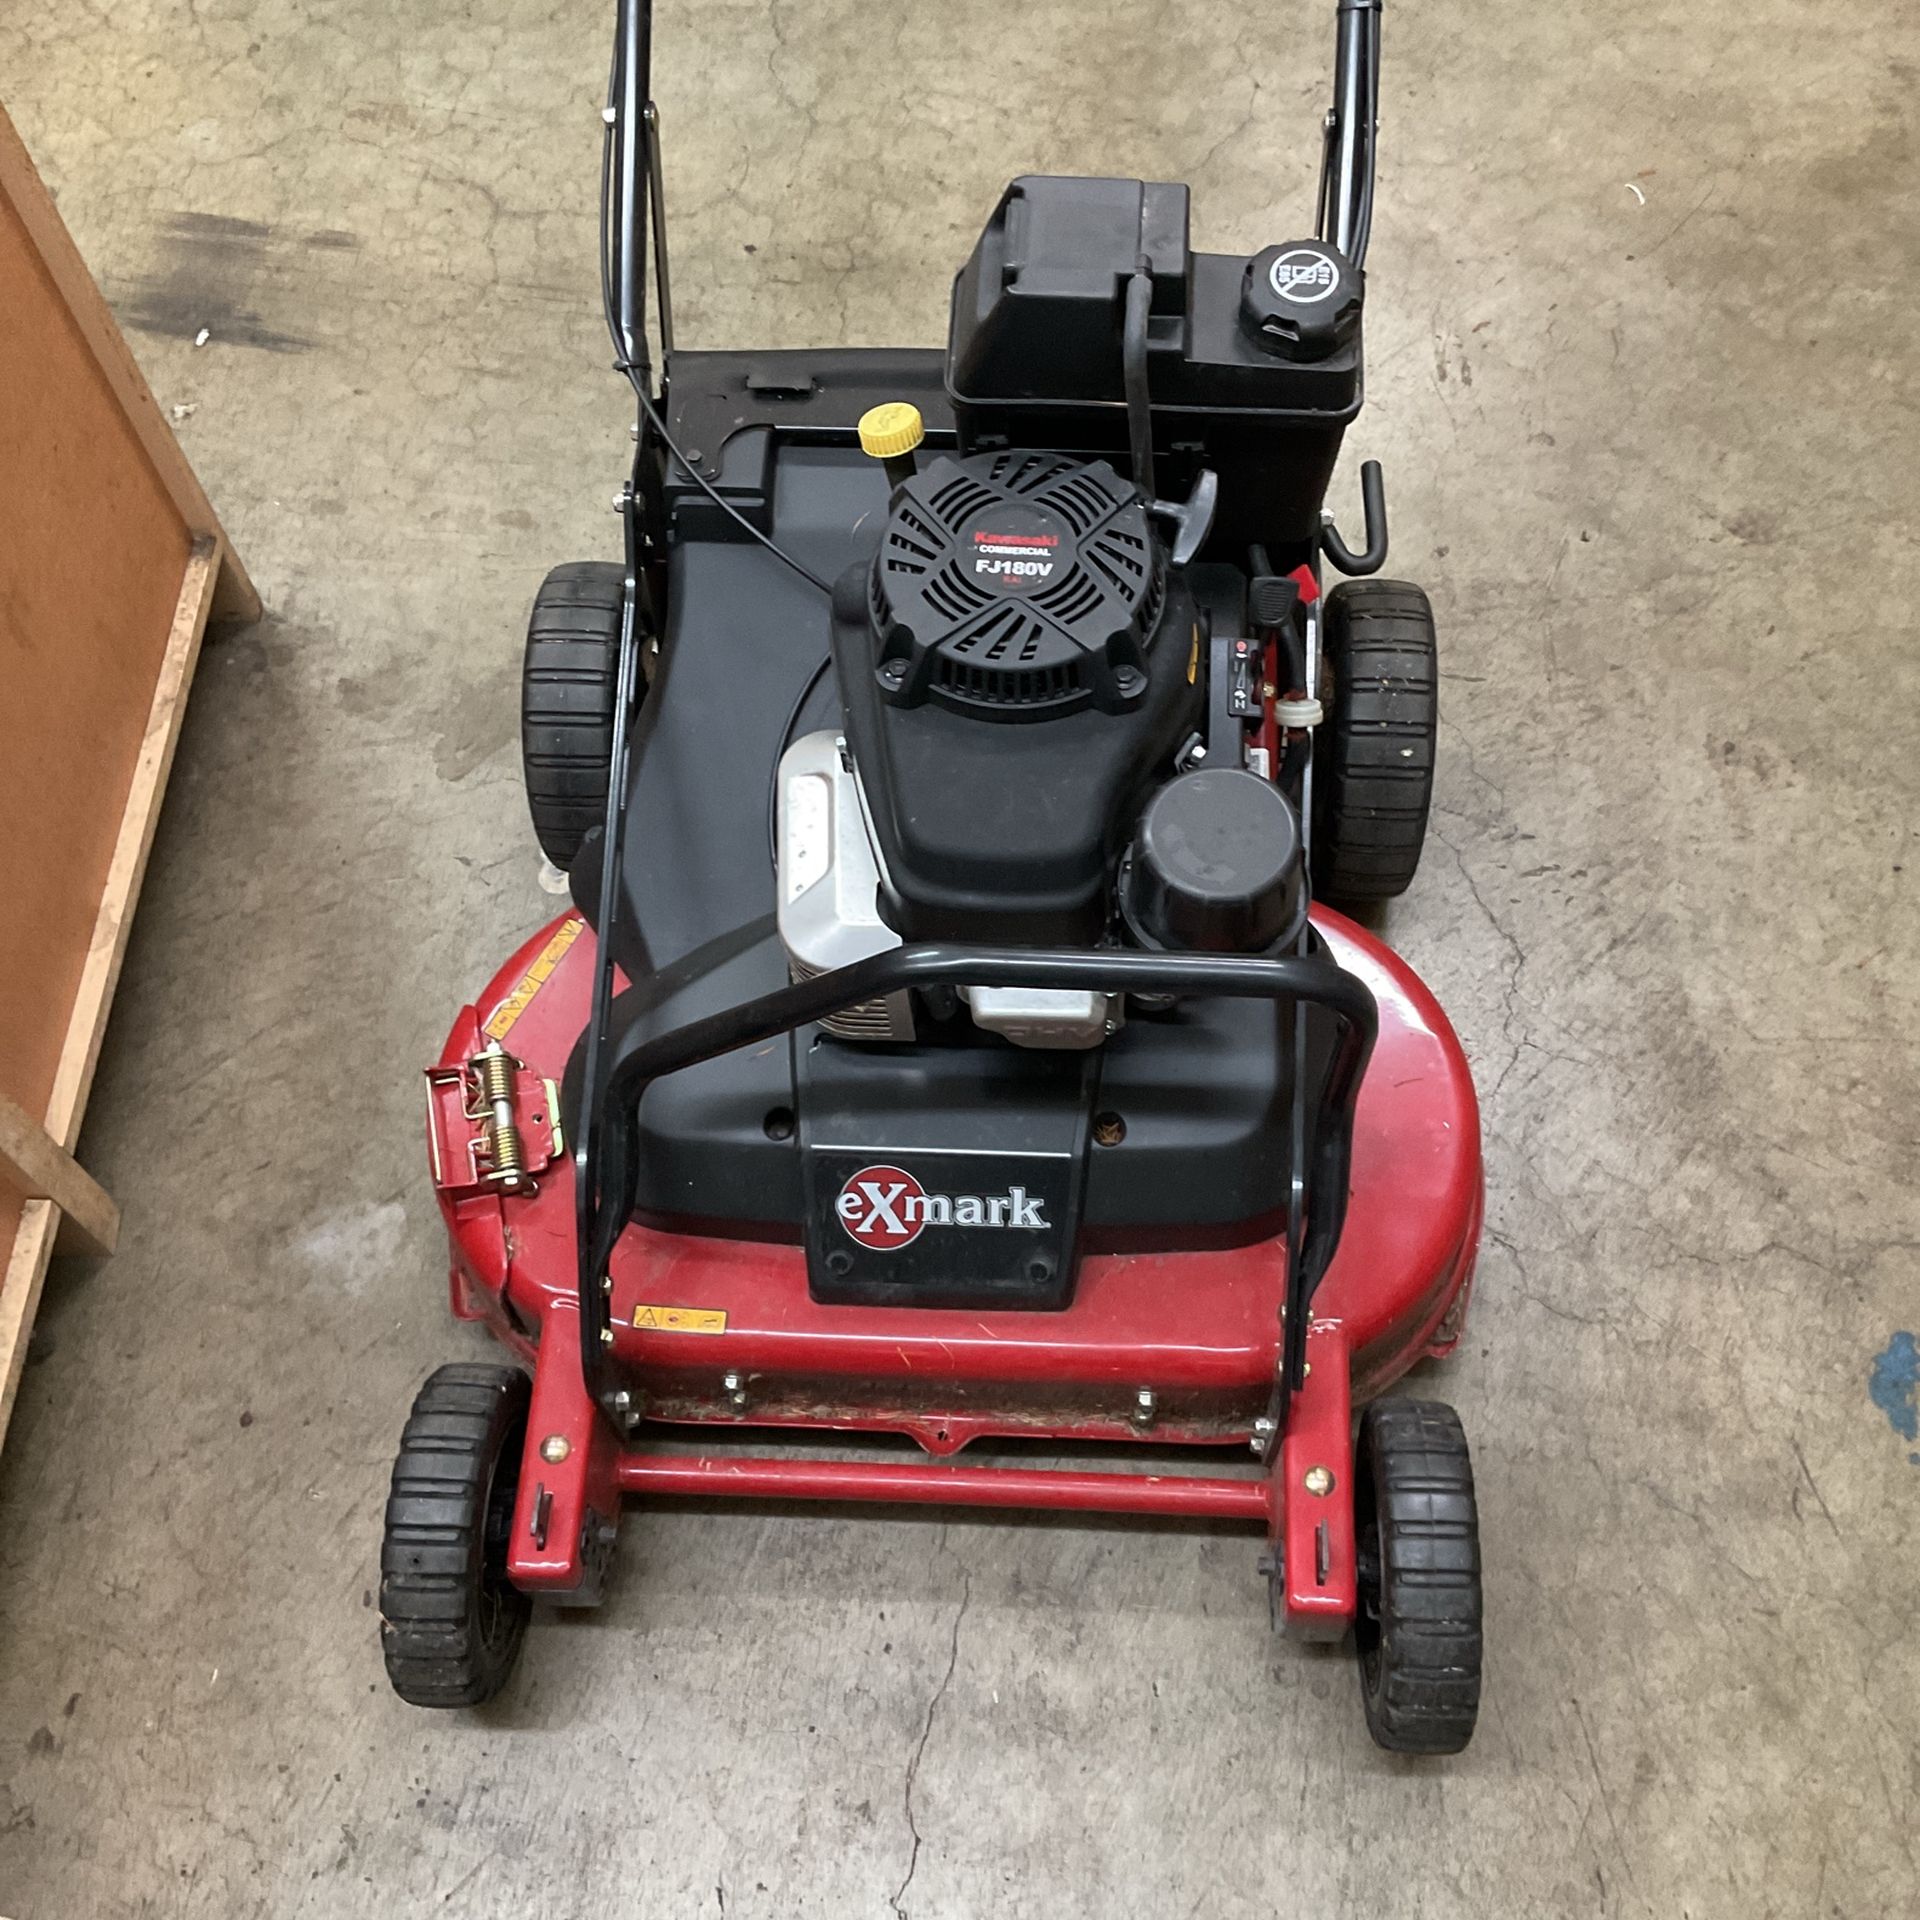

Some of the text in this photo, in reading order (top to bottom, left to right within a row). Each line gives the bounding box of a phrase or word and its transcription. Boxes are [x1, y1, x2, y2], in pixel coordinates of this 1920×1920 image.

[979, 545, 1052, 557] COMMERCIAL
[975, 559, 1054, 577] FJ180V
[836, 1181, 1052, 1235] eXmark
